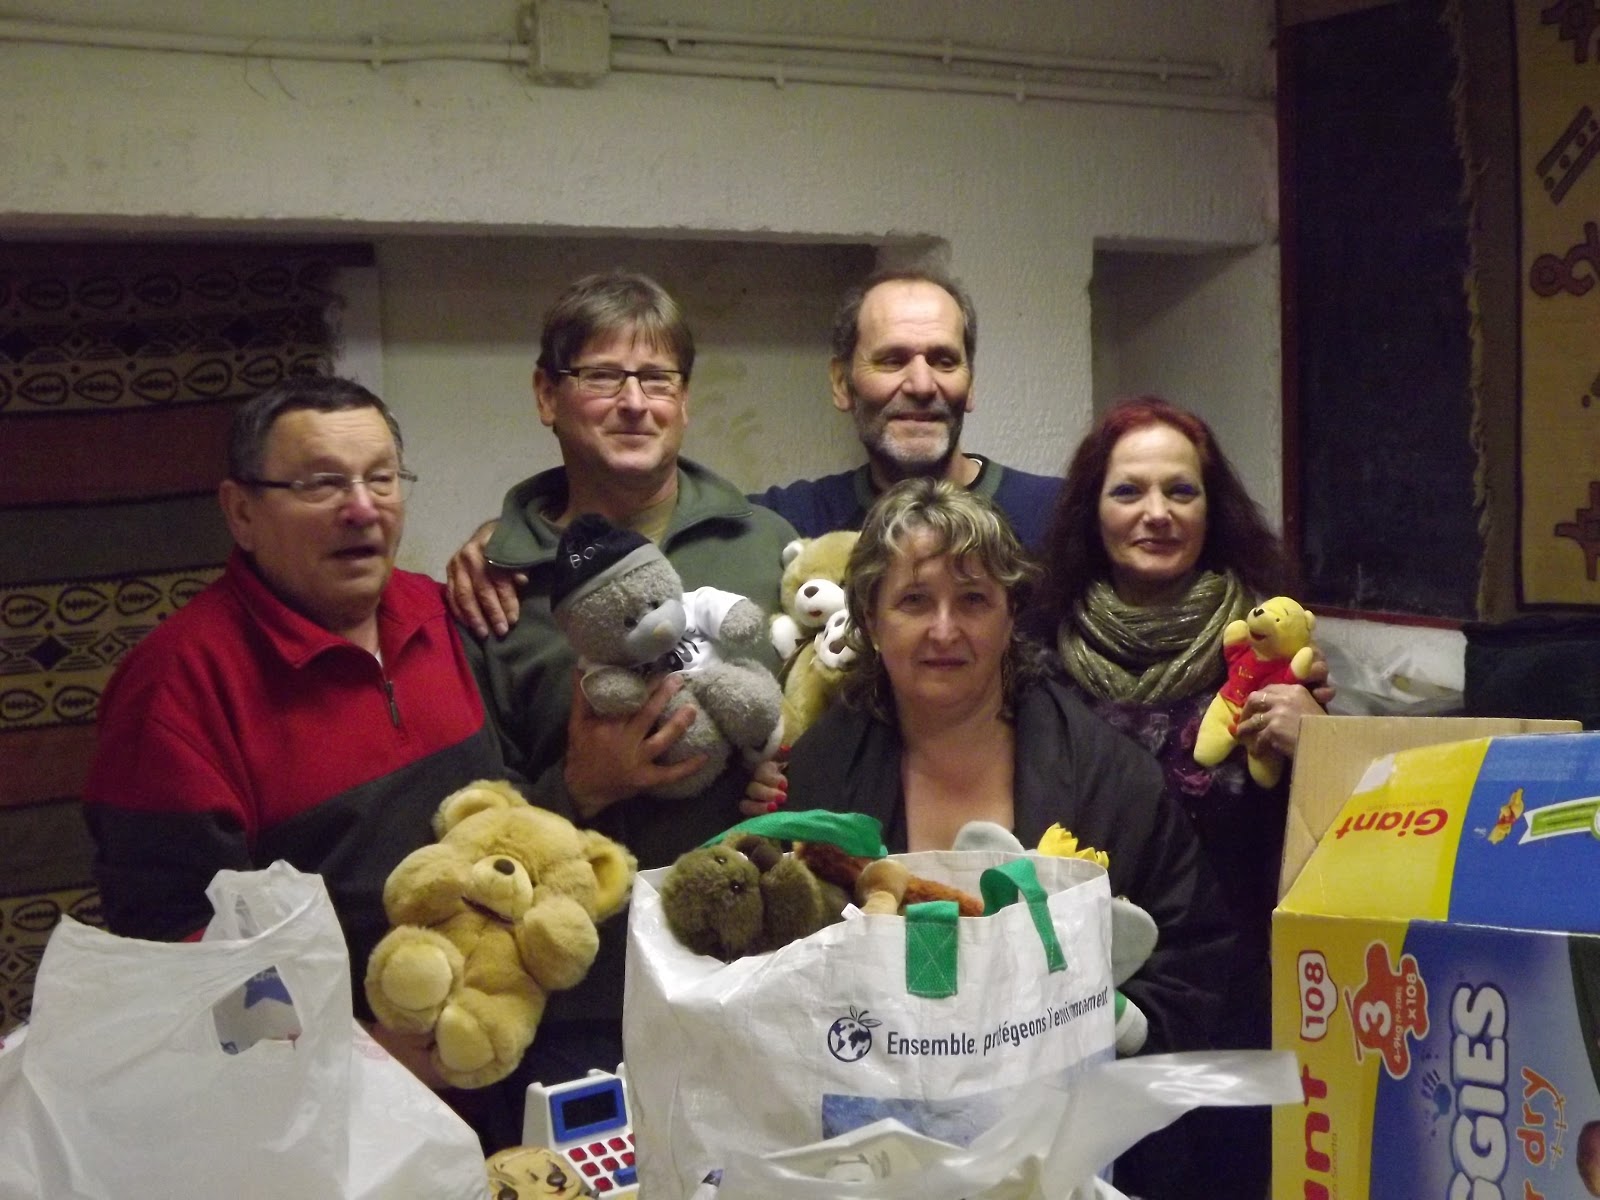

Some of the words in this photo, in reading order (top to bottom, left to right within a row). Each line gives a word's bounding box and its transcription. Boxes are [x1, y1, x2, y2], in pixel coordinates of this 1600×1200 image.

[1335, 807, 1449, 840] Giant
[1304, 961, 1325, 1029] 108
[1359, 1000, 1391, 1036] 3
[1514, 1066, 1561, 1166] dry
